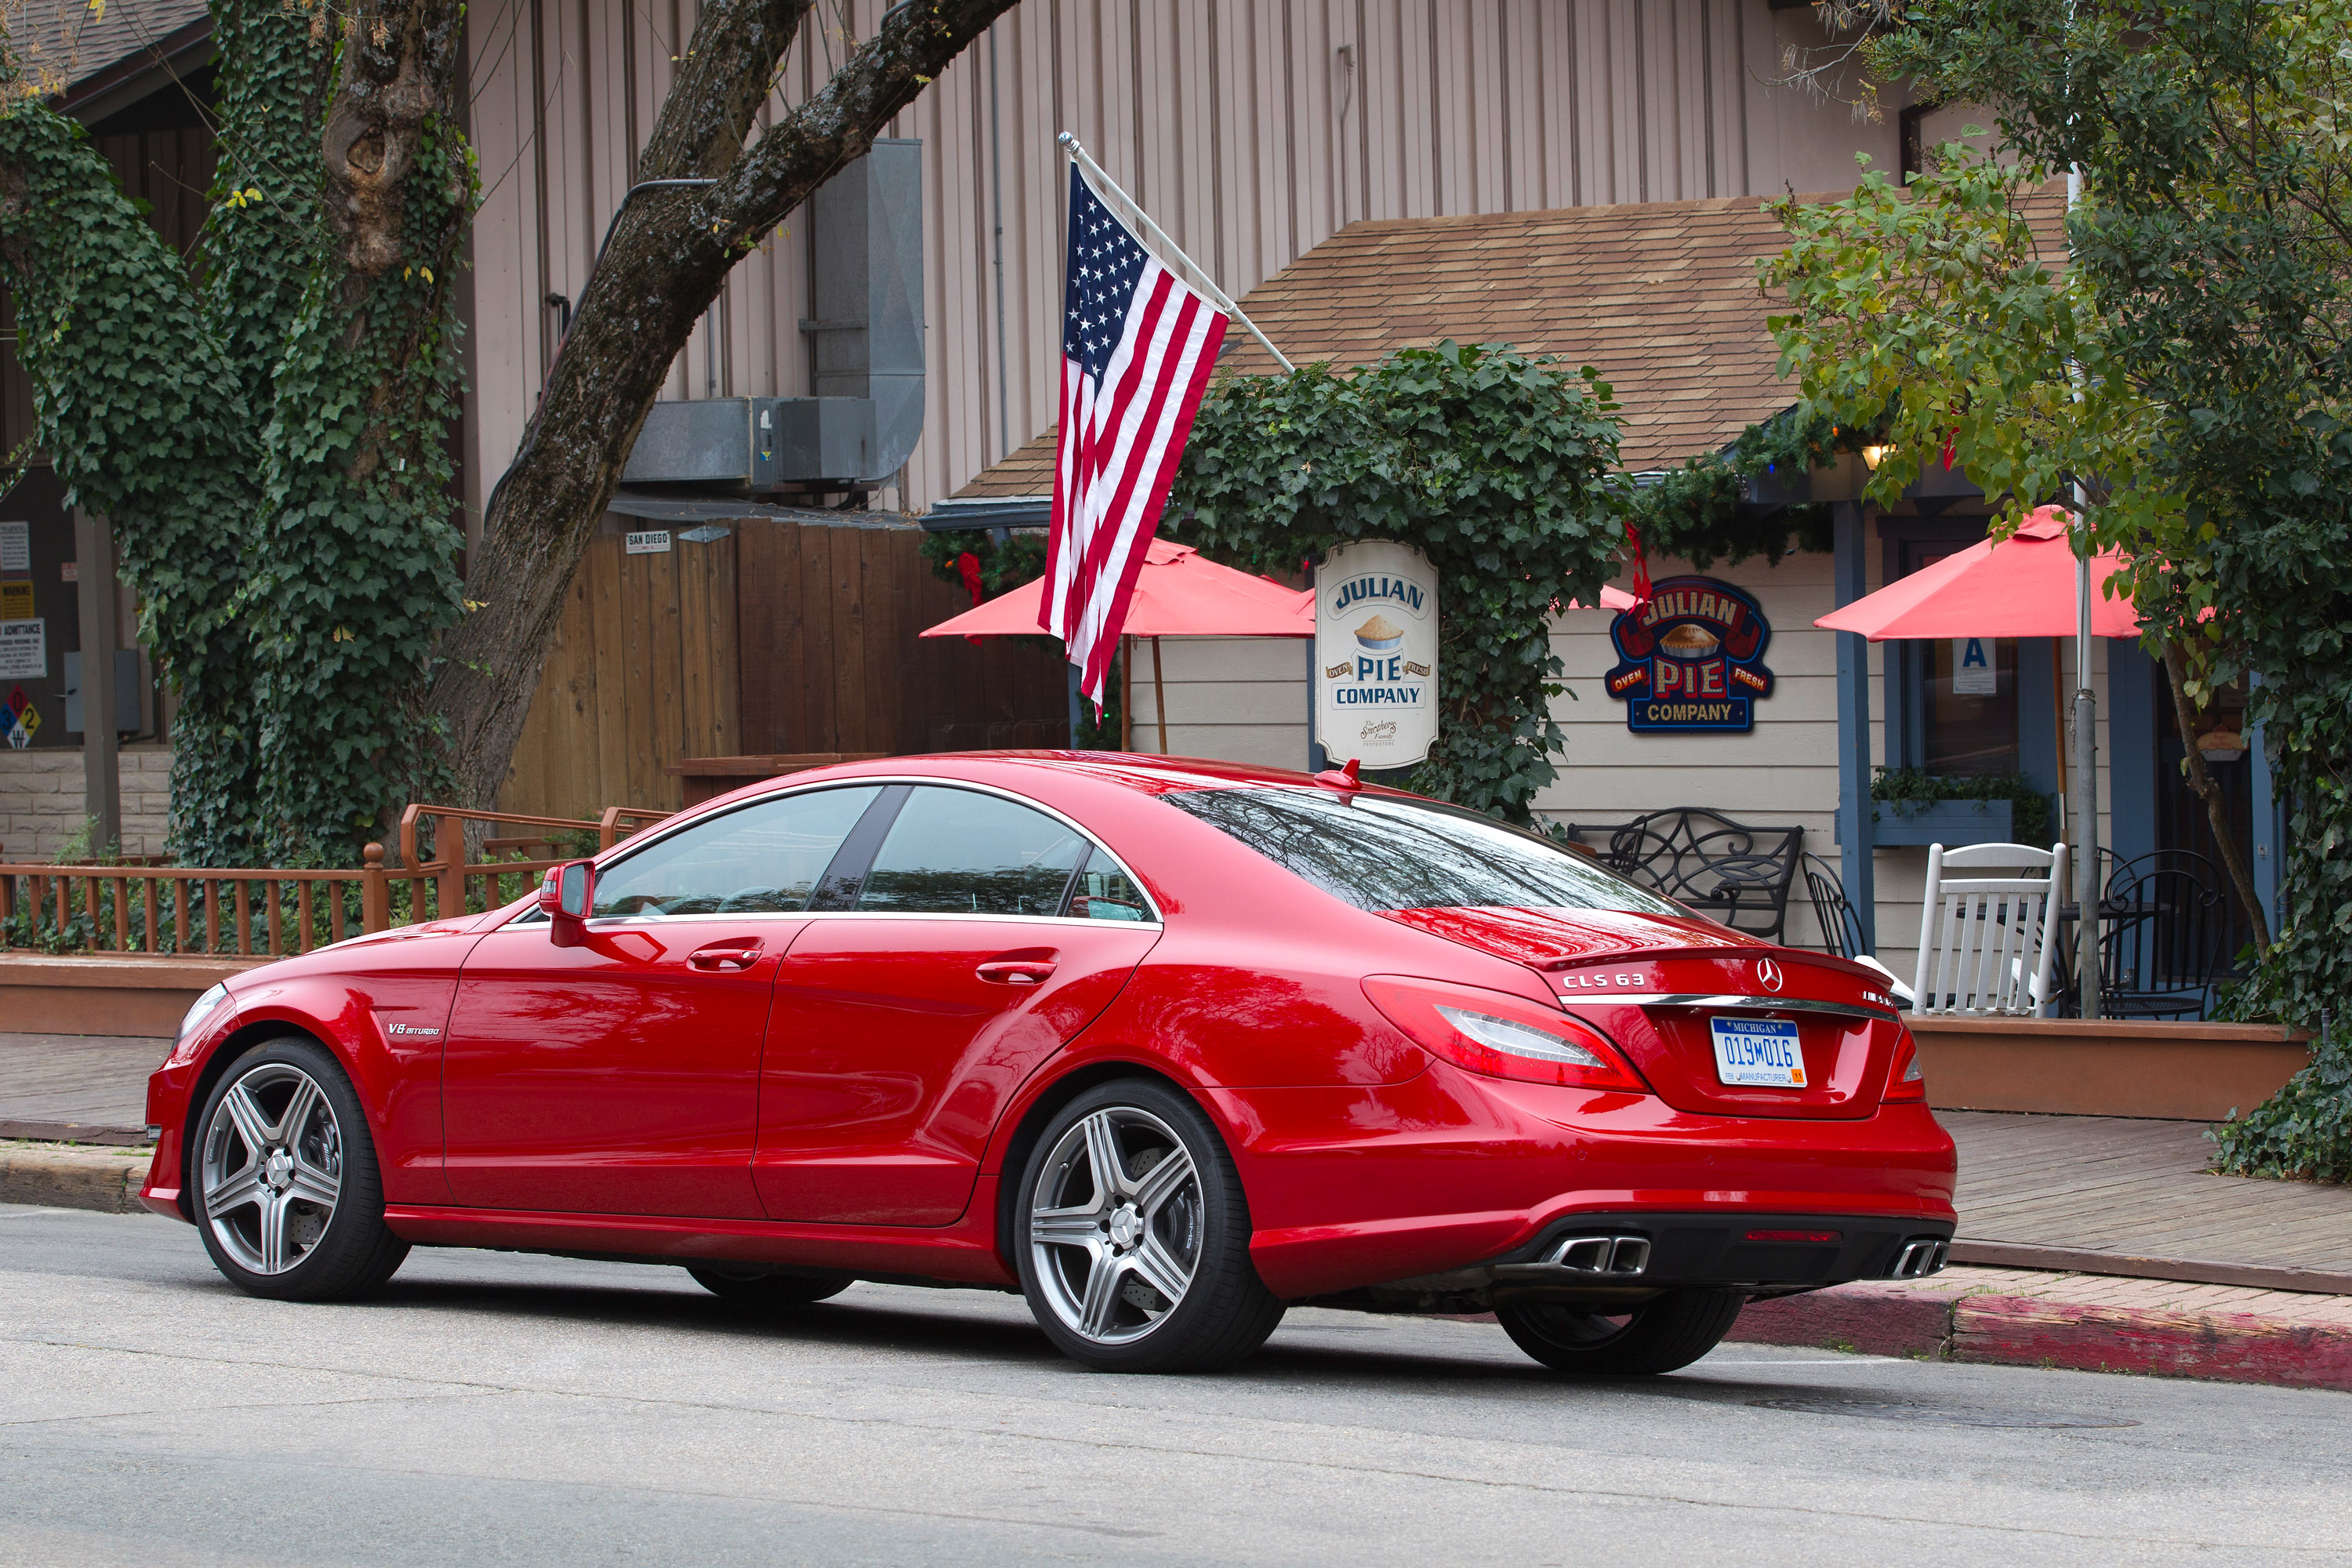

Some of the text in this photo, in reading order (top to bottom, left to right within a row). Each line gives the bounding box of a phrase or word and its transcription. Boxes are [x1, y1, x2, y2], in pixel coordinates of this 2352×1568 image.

[629, 533, 667, 545] SAN DIEGO
[1335, 577, 1425, 611] JULIAN
[1642, 591, 1737, 626] JULIAN
[4, 623, 42, 636] ADMITTANCE
[1962, 637, 1987, 667] A
[1329, 662, 1429, 677] OVEN FRESH
[1357, 655, 1402, 681] PIE
[1656, 657, 1724, 695] PIE
[1615, 667, 1765, 690] OVEN FRESH
[13, 691, 23, 712] 0
[1337, 688, 1421, 704] COMPANY
[2, 710, 11, 730] 3
[25, 708, 34, 729] 2
[1647, 704, 1732, 721] COMPANY
[1563, 973, 1645, 989] CLS 63
[389, 1023, 407, 1034] V8
[1733, 1022, 1777, 1033] MICHIGAN
[1725, 1036, 1793, 1067] 019M016
[1740, 1072, 1787, 1082] MANUFACTURER
